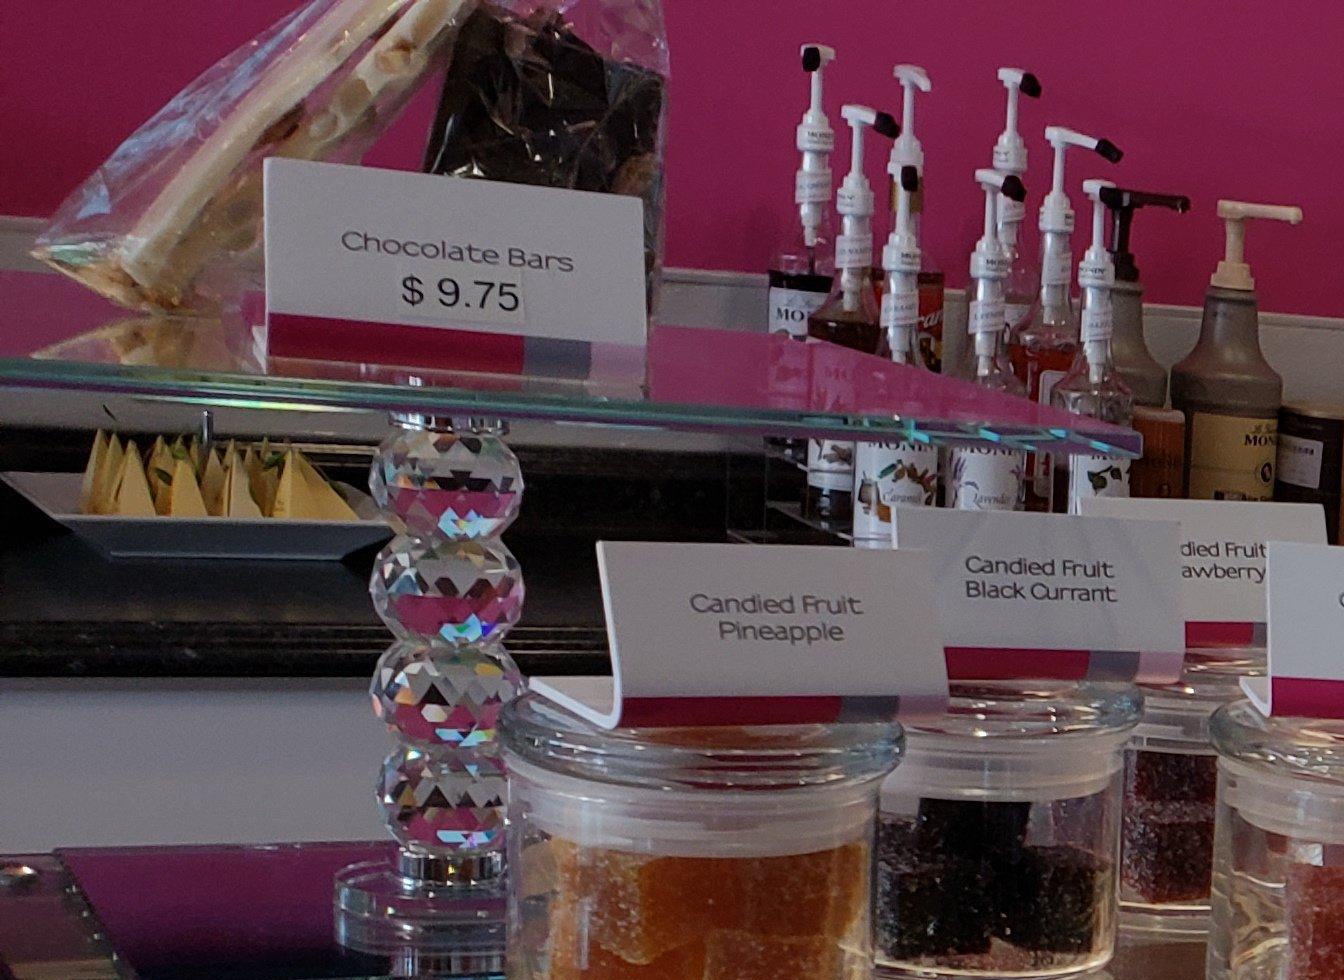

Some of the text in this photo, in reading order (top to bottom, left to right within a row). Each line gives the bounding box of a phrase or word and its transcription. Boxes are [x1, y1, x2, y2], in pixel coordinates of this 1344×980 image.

[341, 229, 574, 273] Chocolate Bars
[402, 273, 520, 312] $ 9.75
[776, 306, 811, 322] MO
[1181, 541, 1266, 559] died Fruit
[965, 555, 1115, 579] Candied Fruit
[1182, 563, 1266, 584] awberry
[965, 581, 1118, 602] Black Currant
[689, 593, 865, 616] Candied Fruit
[718, 620, 846, 646] Pineapple
